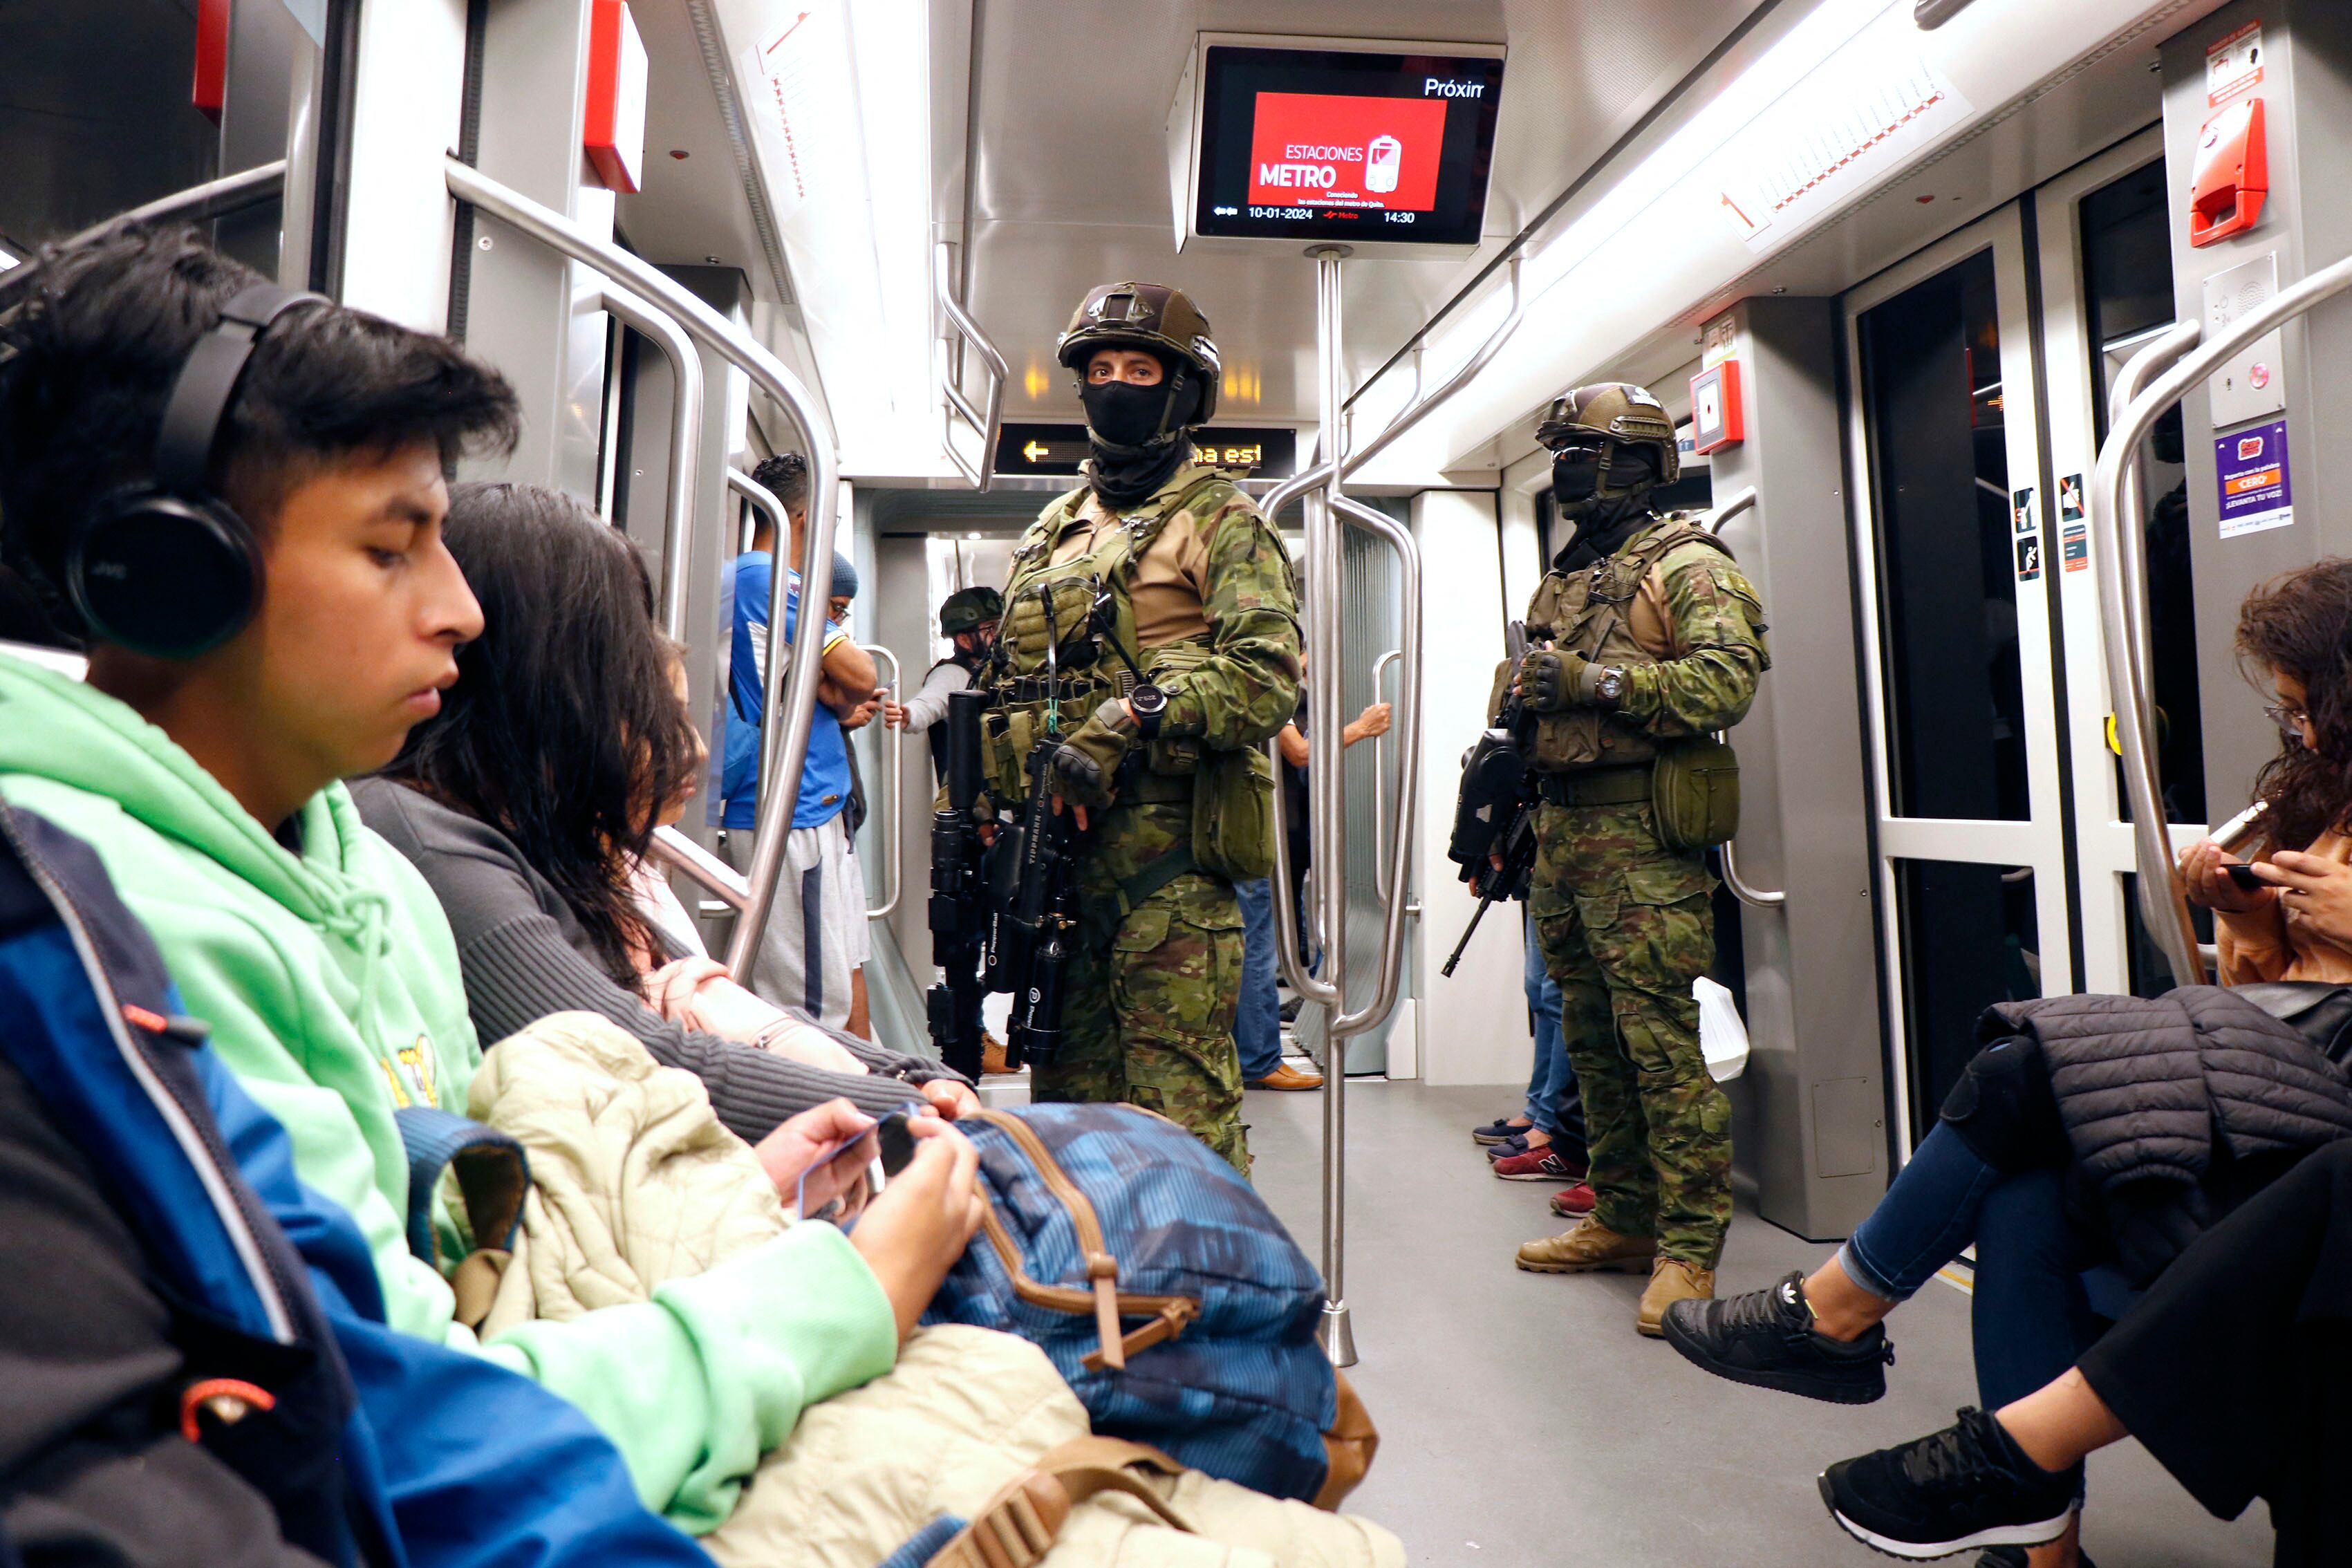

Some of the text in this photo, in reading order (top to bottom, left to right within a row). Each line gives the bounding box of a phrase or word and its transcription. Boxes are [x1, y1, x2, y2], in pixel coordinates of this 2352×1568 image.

[1286, 144, 1363, 162] ESTACIONES
[1260, 163, 1336, 189] METRO
[1249, 207, 1313, 220] 10-01-2024
[1384, 212, 1415, 223] 14:30
[1029, 814, 1042, 864] TIPPMANN
[1538, 1154, 1568, 1173] N
